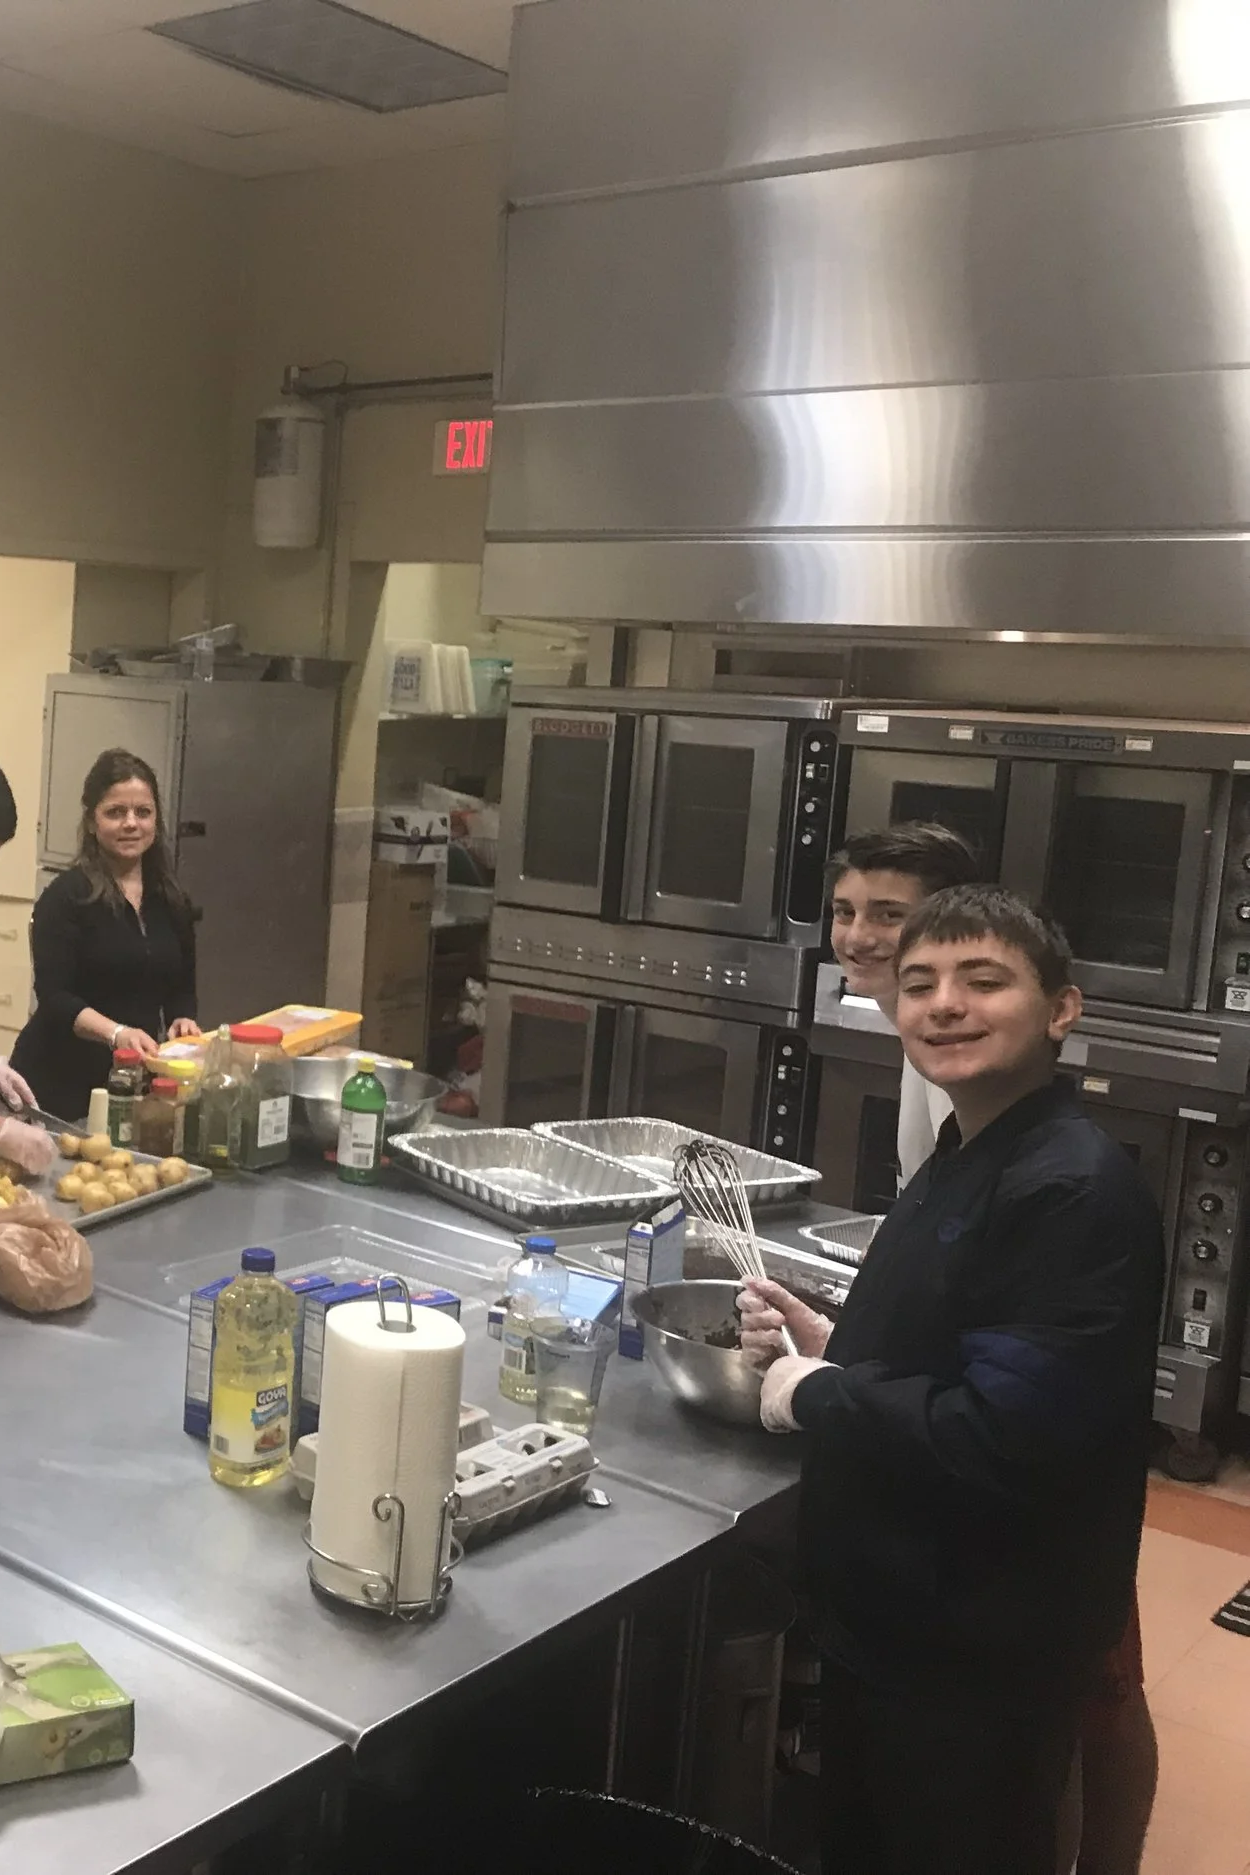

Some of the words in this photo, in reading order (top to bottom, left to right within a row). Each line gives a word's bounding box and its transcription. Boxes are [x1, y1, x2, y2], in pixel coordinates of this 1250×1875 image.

[446, 421, 493, 468] EXI
[1068, 737, 1114, 751] PRIDE
[257, 1386, 287, 1405] GOYA
